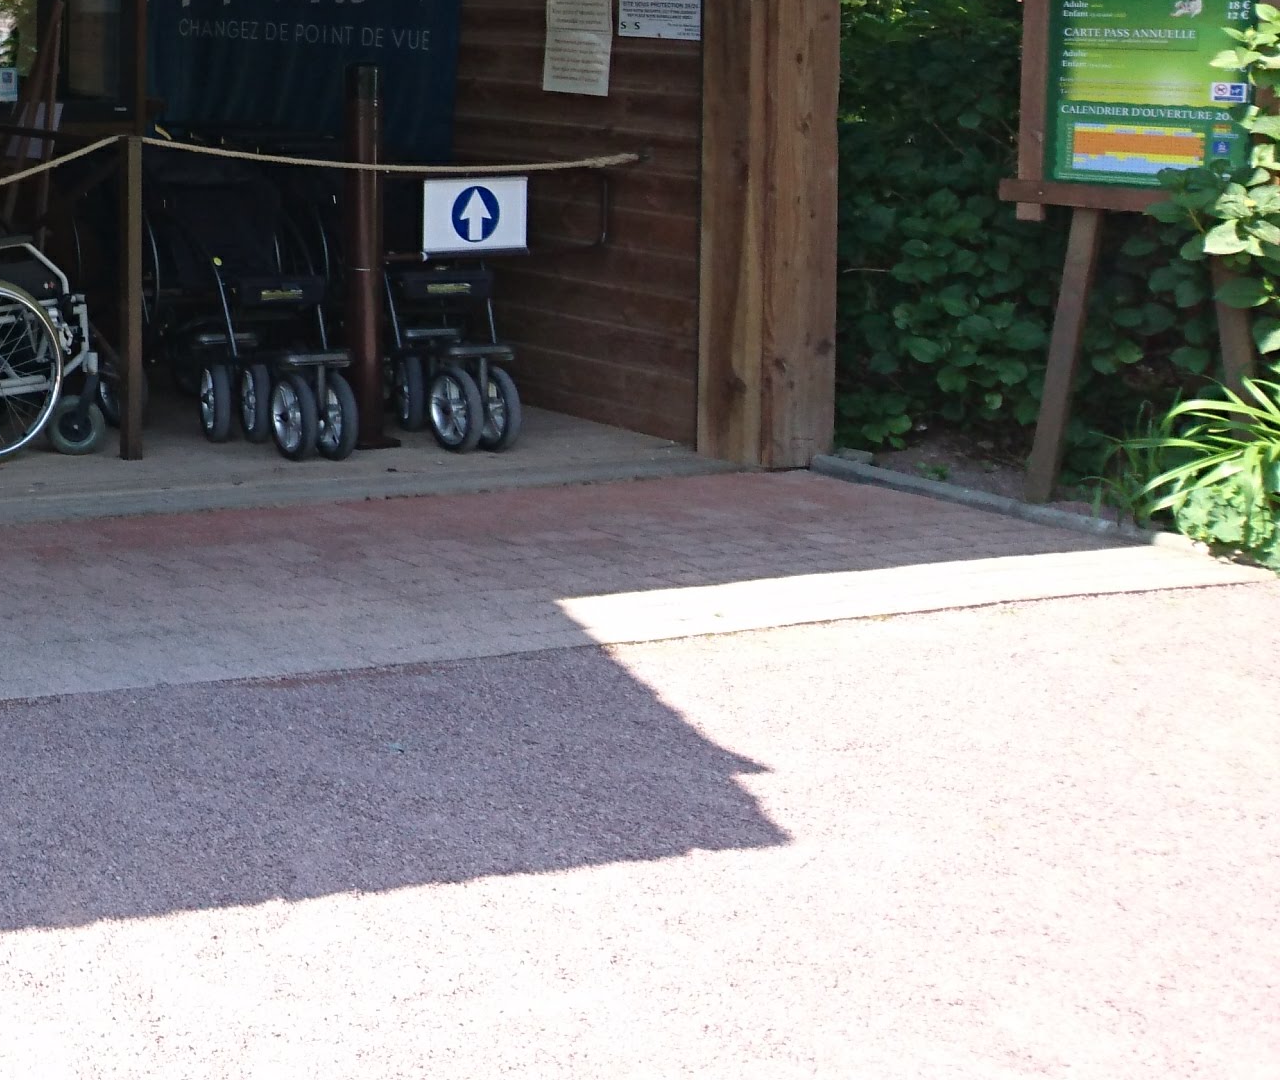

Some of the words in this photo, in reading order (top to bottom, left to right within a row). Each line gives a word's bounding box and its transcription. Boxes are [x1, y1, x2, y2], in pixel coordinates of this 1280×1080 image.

[1063, 0, 1089, 8] Adulte
[1063, 9, 1088, 17] Enfant
[179, 19, 258, 40] CHANGEZ
[265, 23, 289, 41] DE
[295, 24, 354, 45] POINT
[362, 27, 384, 47] DE
[391, 29, 431, 51] VUE
[1064, 28, 1101, 37] CARTE
[1104, 28, 1130, 38] PASS
[1132, 29, 1197, 39] ANNUELLE
[1061, 105, 1129, 116] CALENDRIER
[1131, 108, 1212, 120] D'OUVERTURE
